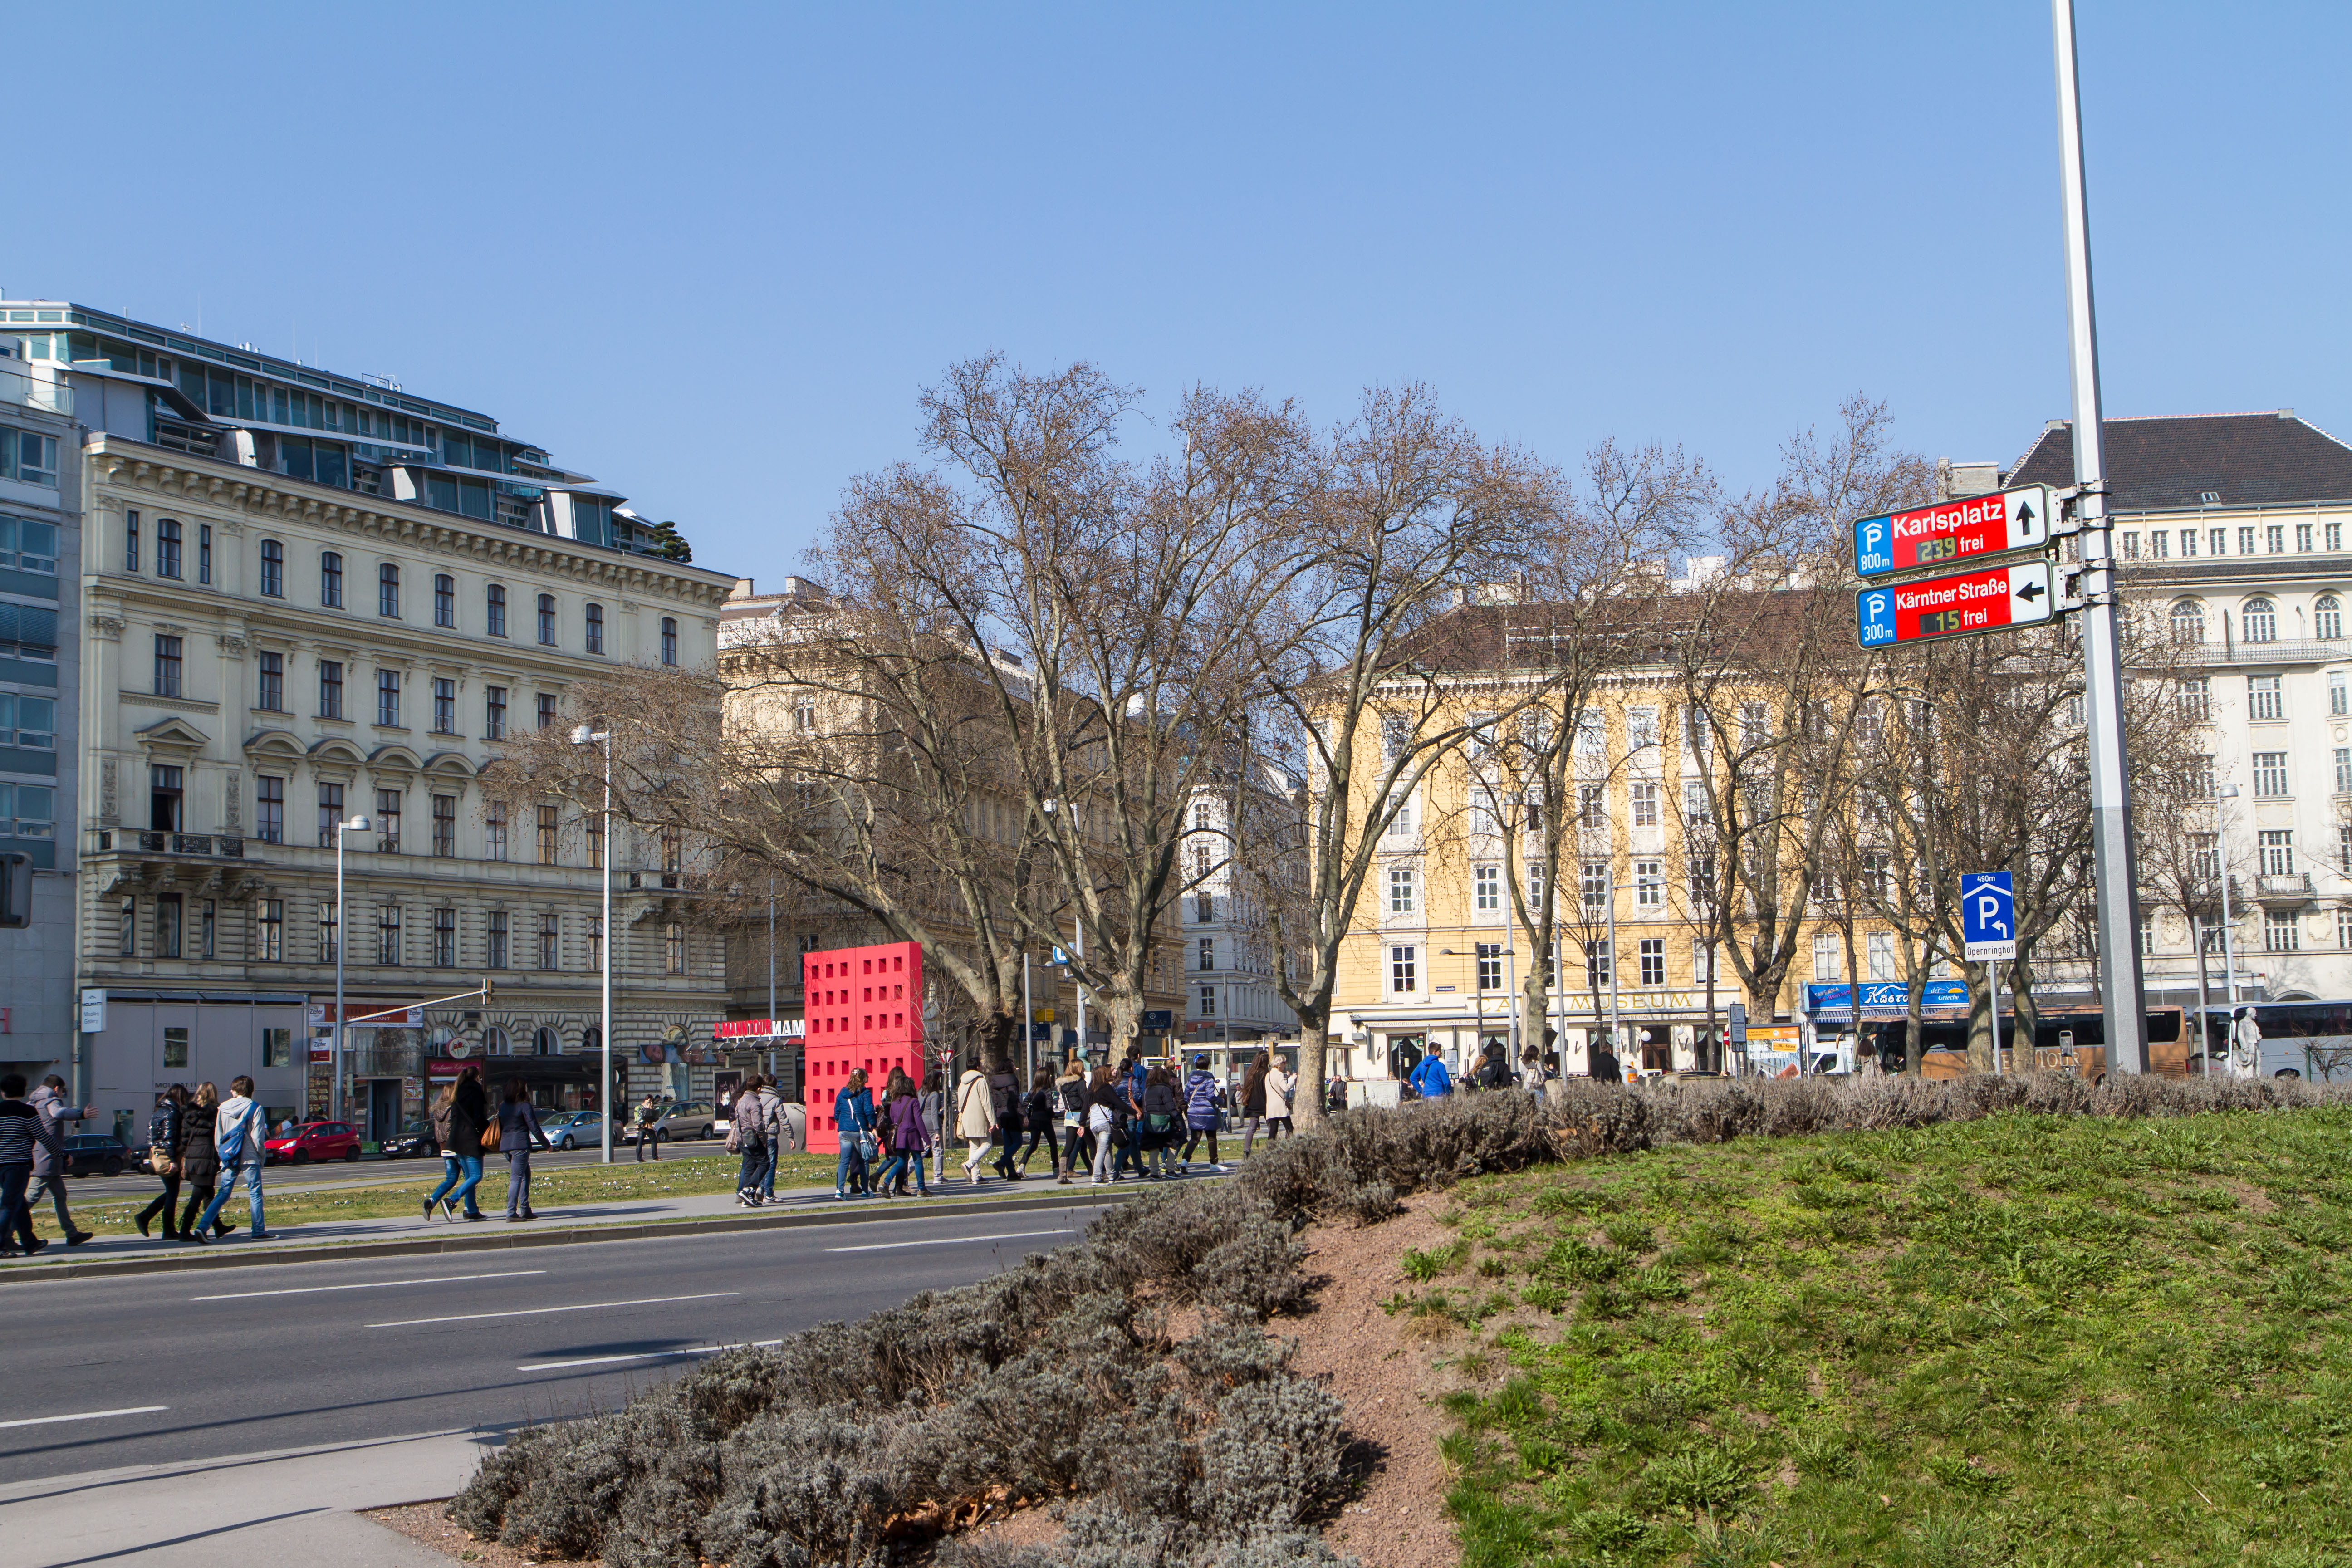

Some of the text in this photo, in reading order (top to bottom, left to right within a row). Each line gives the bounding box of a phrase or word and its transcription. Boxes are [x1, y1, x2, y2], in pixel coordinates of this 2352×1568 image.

[1893, 501, 2003, 538] Karlsplatz
[1867, 529, 1882, 552] P
[1921, 537, 1955, 561] 239
[1960, 534, 1984, 552] frei
[1896, 578, 2007, 610] Kärntner Straße
[1870, 600, 1885, 623] P
[1936, 610, 1959, 632] 15
[1964, 608, 1987, 626] frei
[1979, 896, 1999, 929] P
[1967, 945, 2014, 957] Opernringhof
[714, 1019, 771, 1039] 3.MANNTOUR
